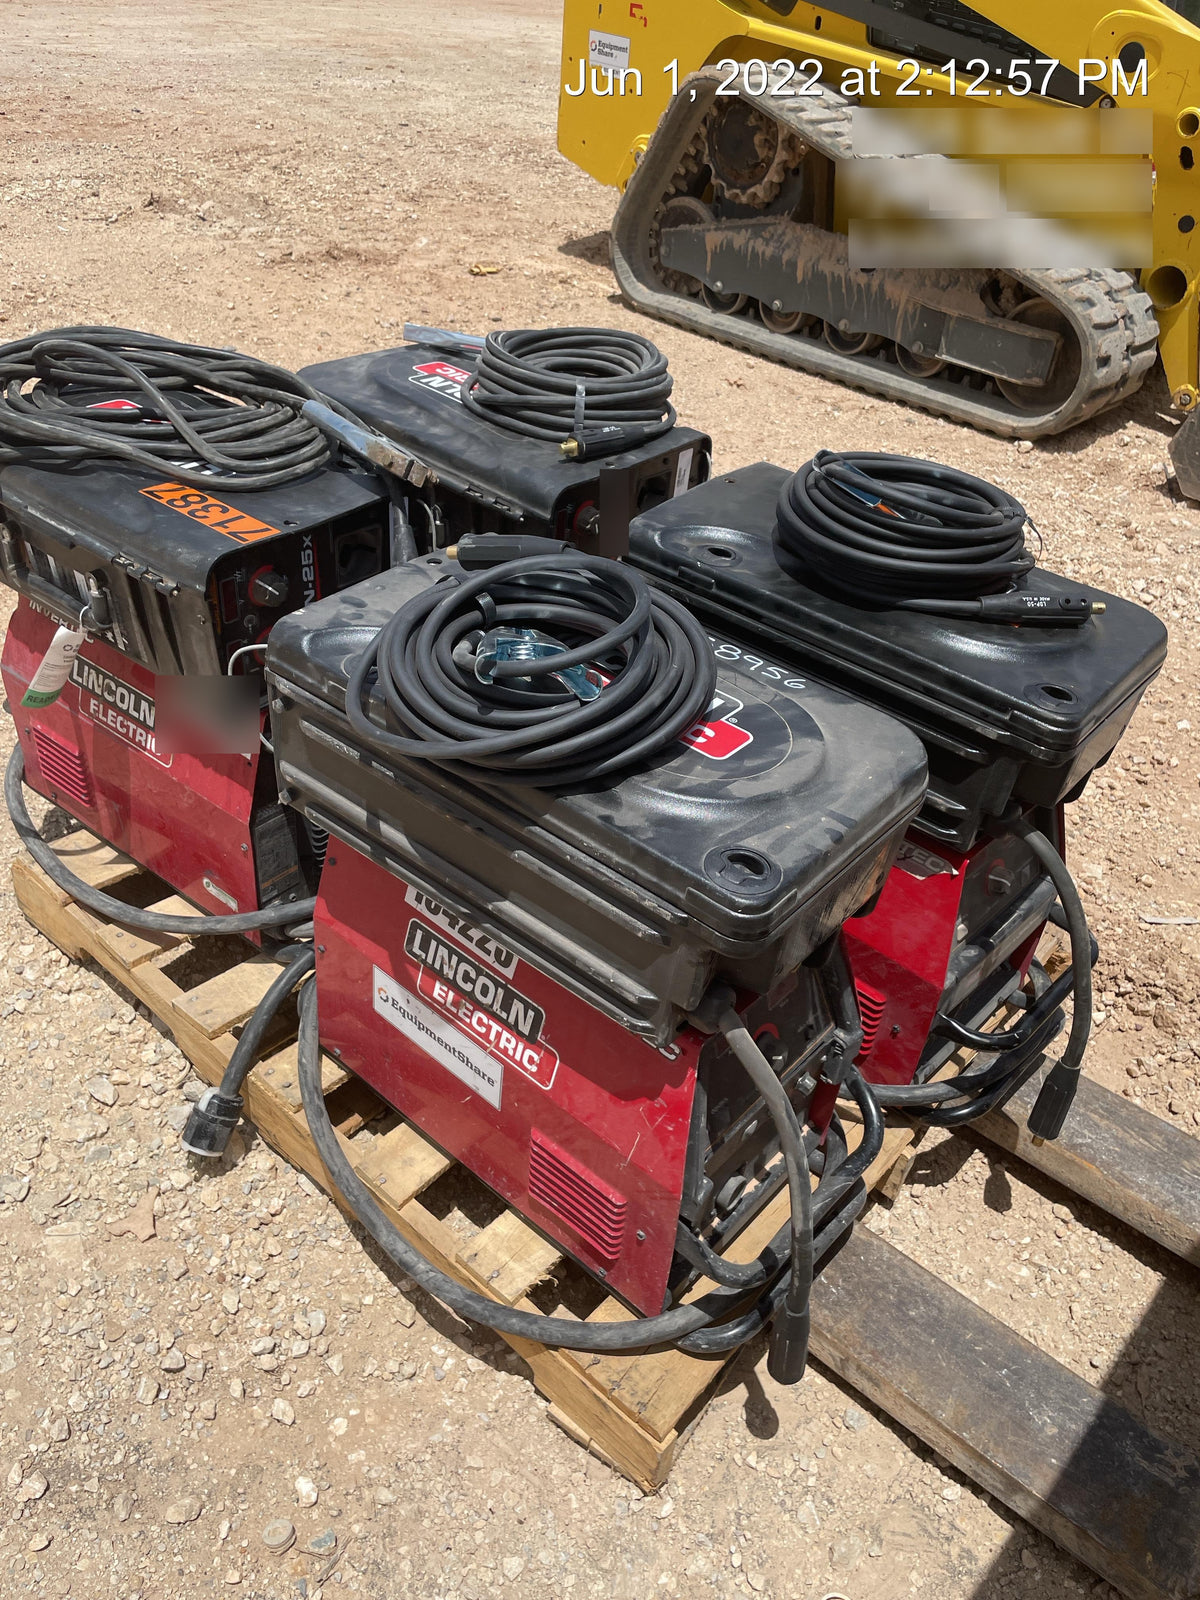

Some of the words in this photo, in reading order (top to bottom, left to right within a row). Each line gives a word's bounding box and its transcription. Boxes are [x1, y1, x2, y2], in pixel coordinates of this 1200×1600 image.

[597, 48, 614, 58] Share
[598, 40, 628, 53] Equipment
[143, 486, 273, 542] 71387
[73, 659, 155, 728] LINCOLN
[708, 637, 808, 690] 8956
[412, 928, 535, 1034] LINCOLN
[390, 997, 495, 1087] EquipmentShare
[432, 981, 540, 1073] ELECTRIC
